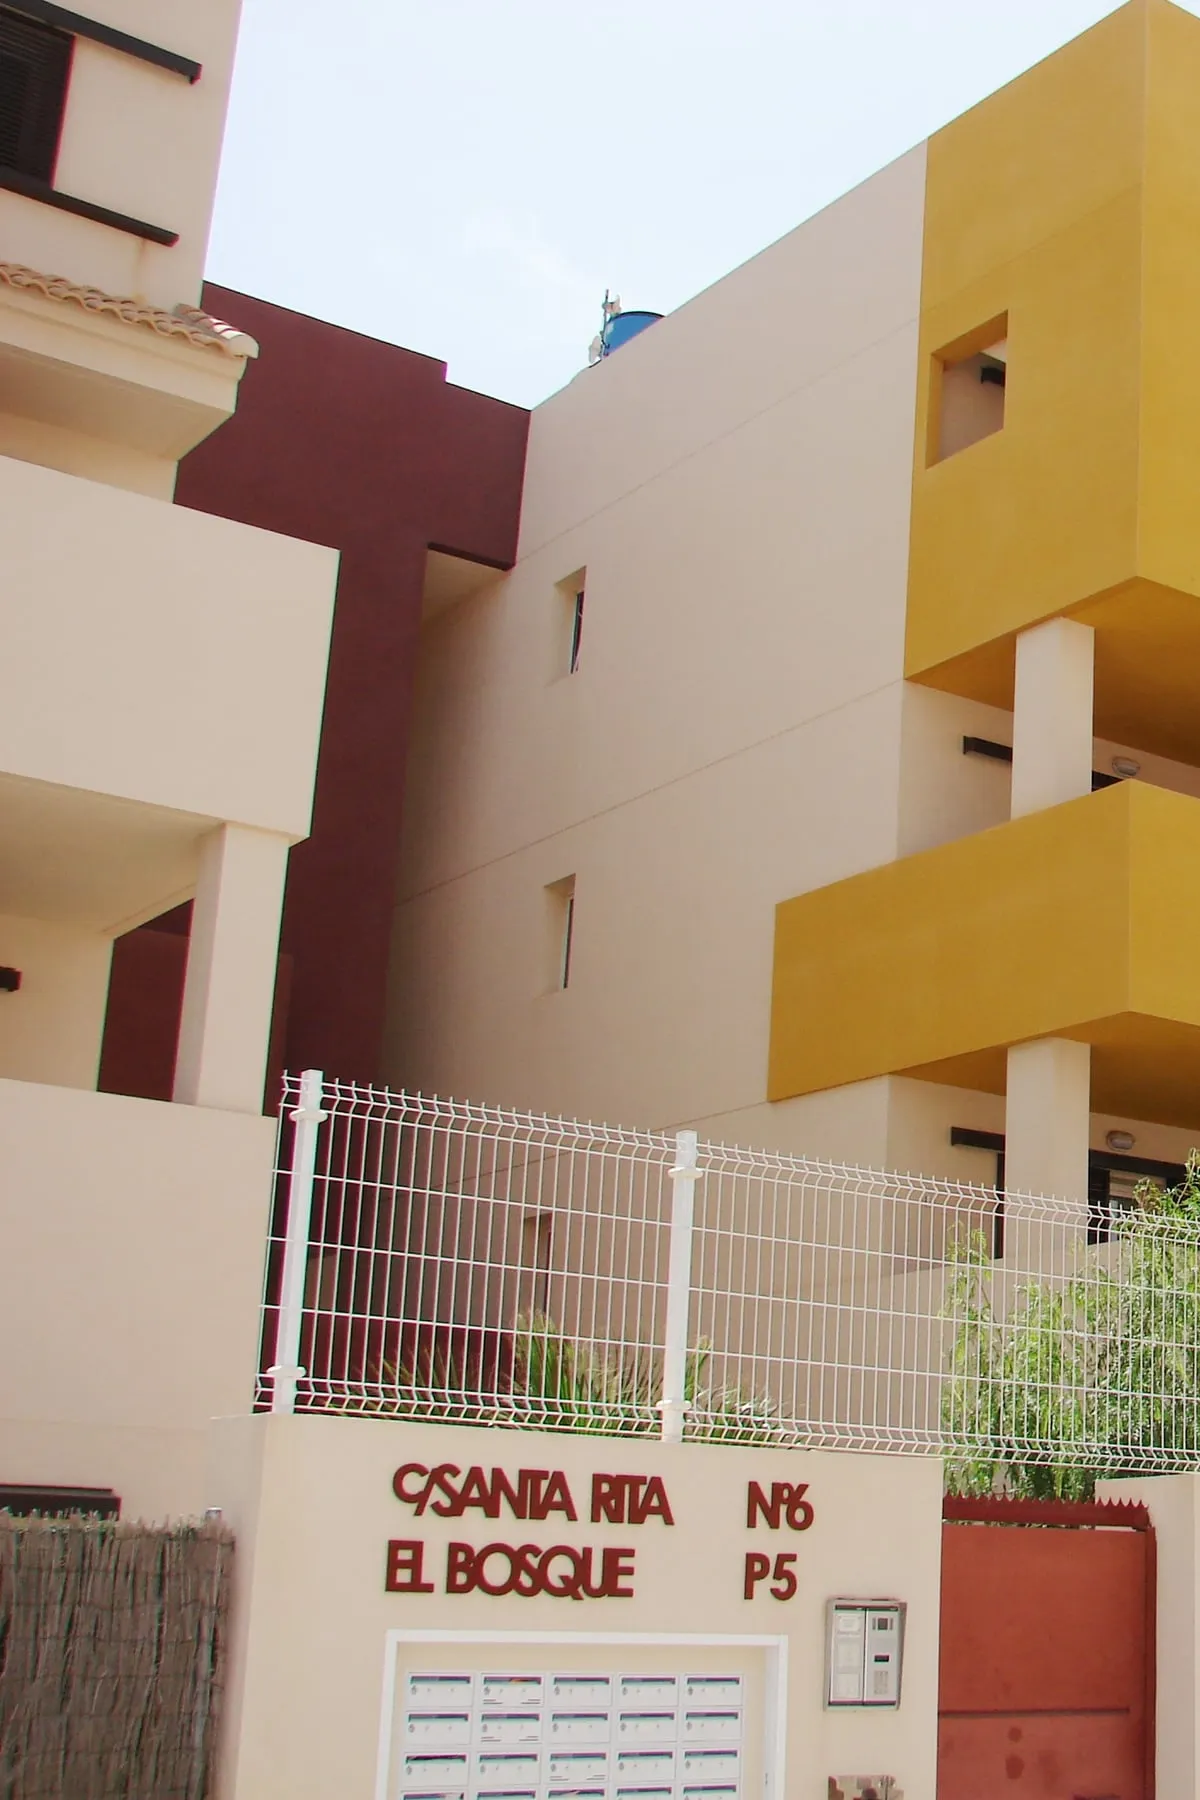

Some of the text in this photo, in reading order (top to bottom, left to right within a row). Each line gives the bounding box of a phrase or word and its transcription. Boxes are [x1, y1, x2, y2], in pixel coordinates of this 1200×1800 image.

[591, 1473, 675, 1525] RITA
[386, 1540, 635, 1600] EL BOSQUE
[744, 1552, 798, 1600] P5
